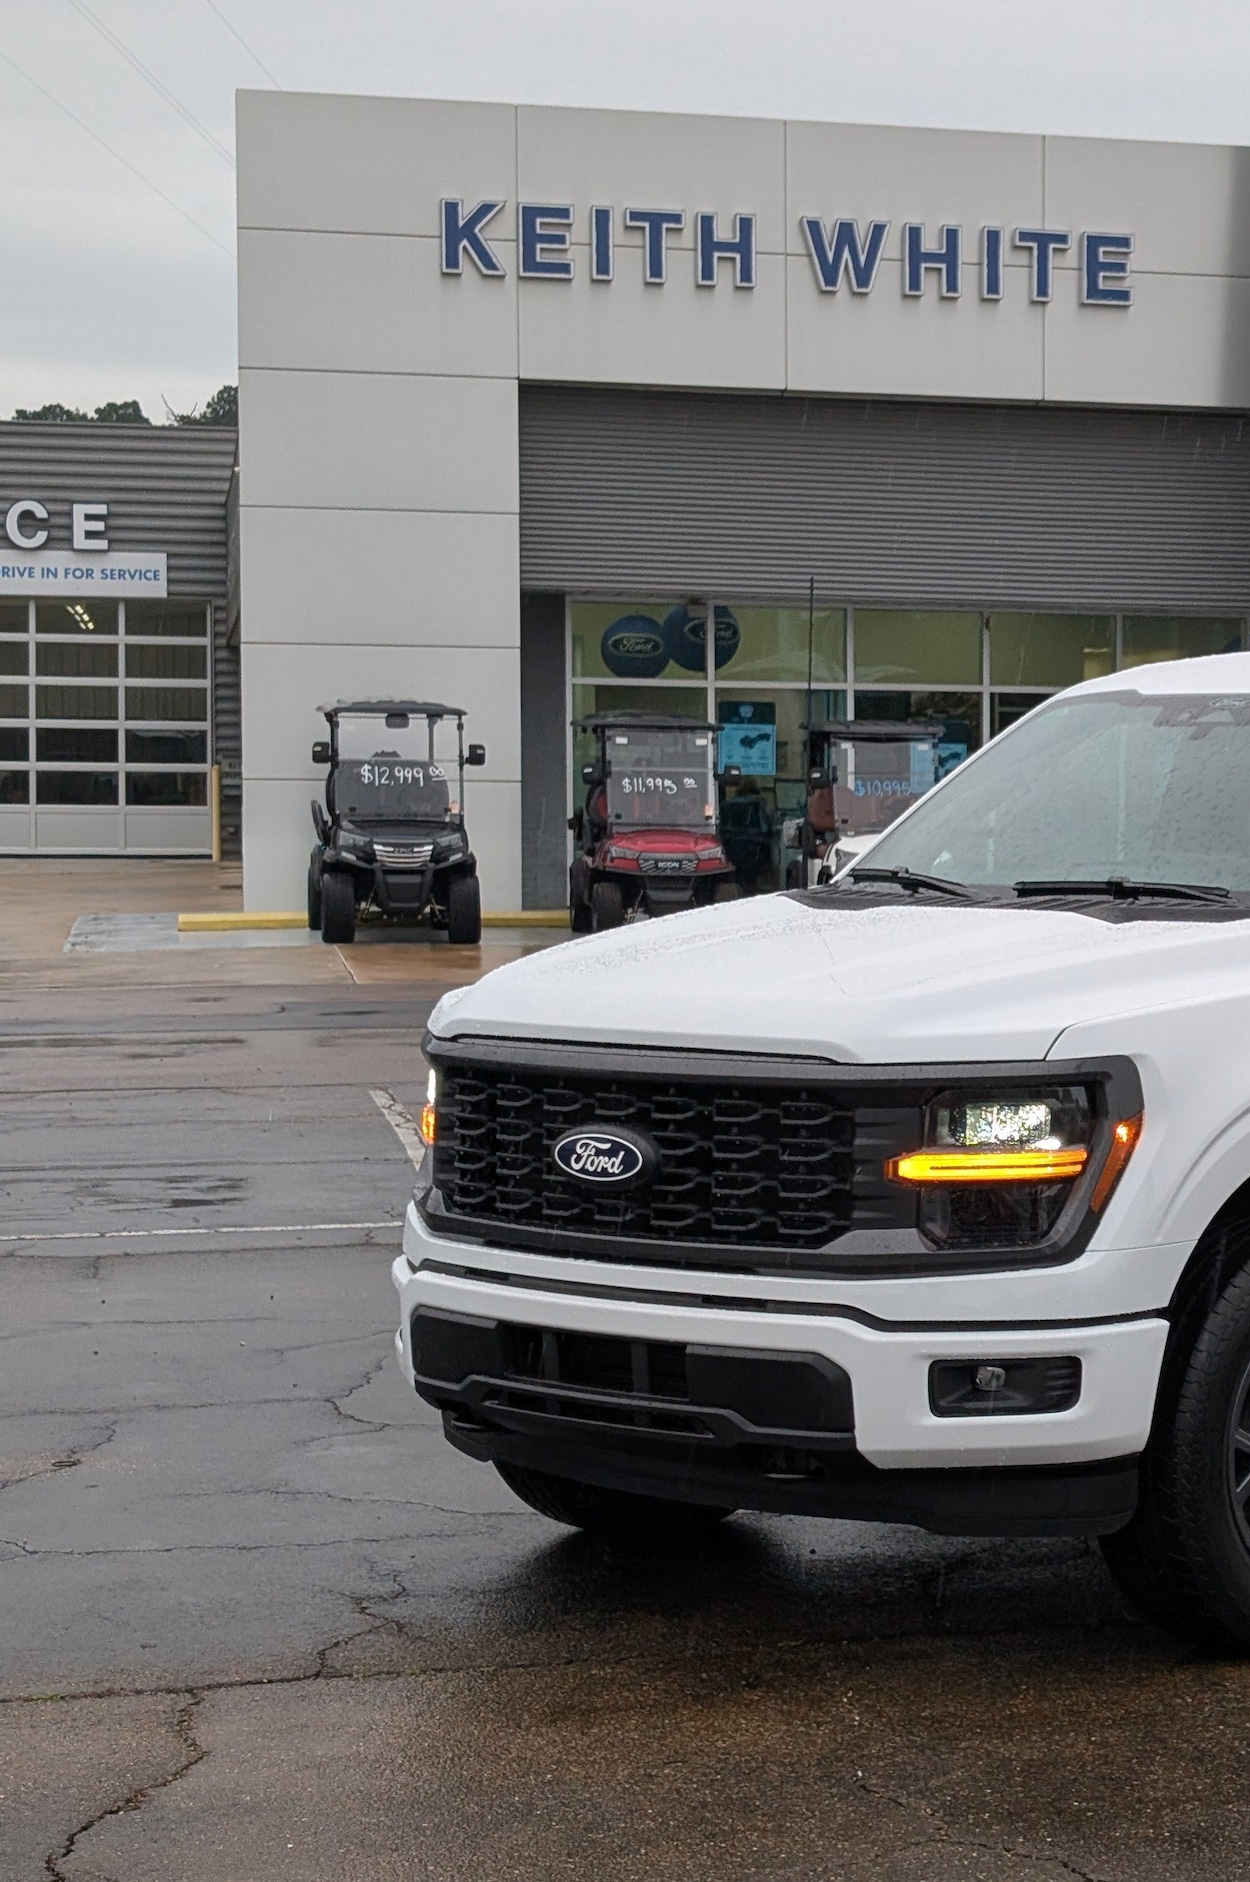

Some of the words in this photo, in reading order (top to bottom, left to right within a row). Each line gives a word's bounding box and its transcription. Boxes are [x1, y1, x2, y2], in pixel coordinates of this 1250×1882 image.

[440, 198, 757, 290] KEITH
[801, 215, 1135, 308] WHITE
[0, 565, 36, 579] RIVE
[40, 567, 58, 580] IN
[64, 568, 95, 581] FOR
[100, 568, 161, 582] SERVICE
[619, 637, 654, 652] Ford
[360, 763, 425, 788] $12,999
[622, 777, 678, 795] $11,995
[570, 1139, 626, 1174] Ford
